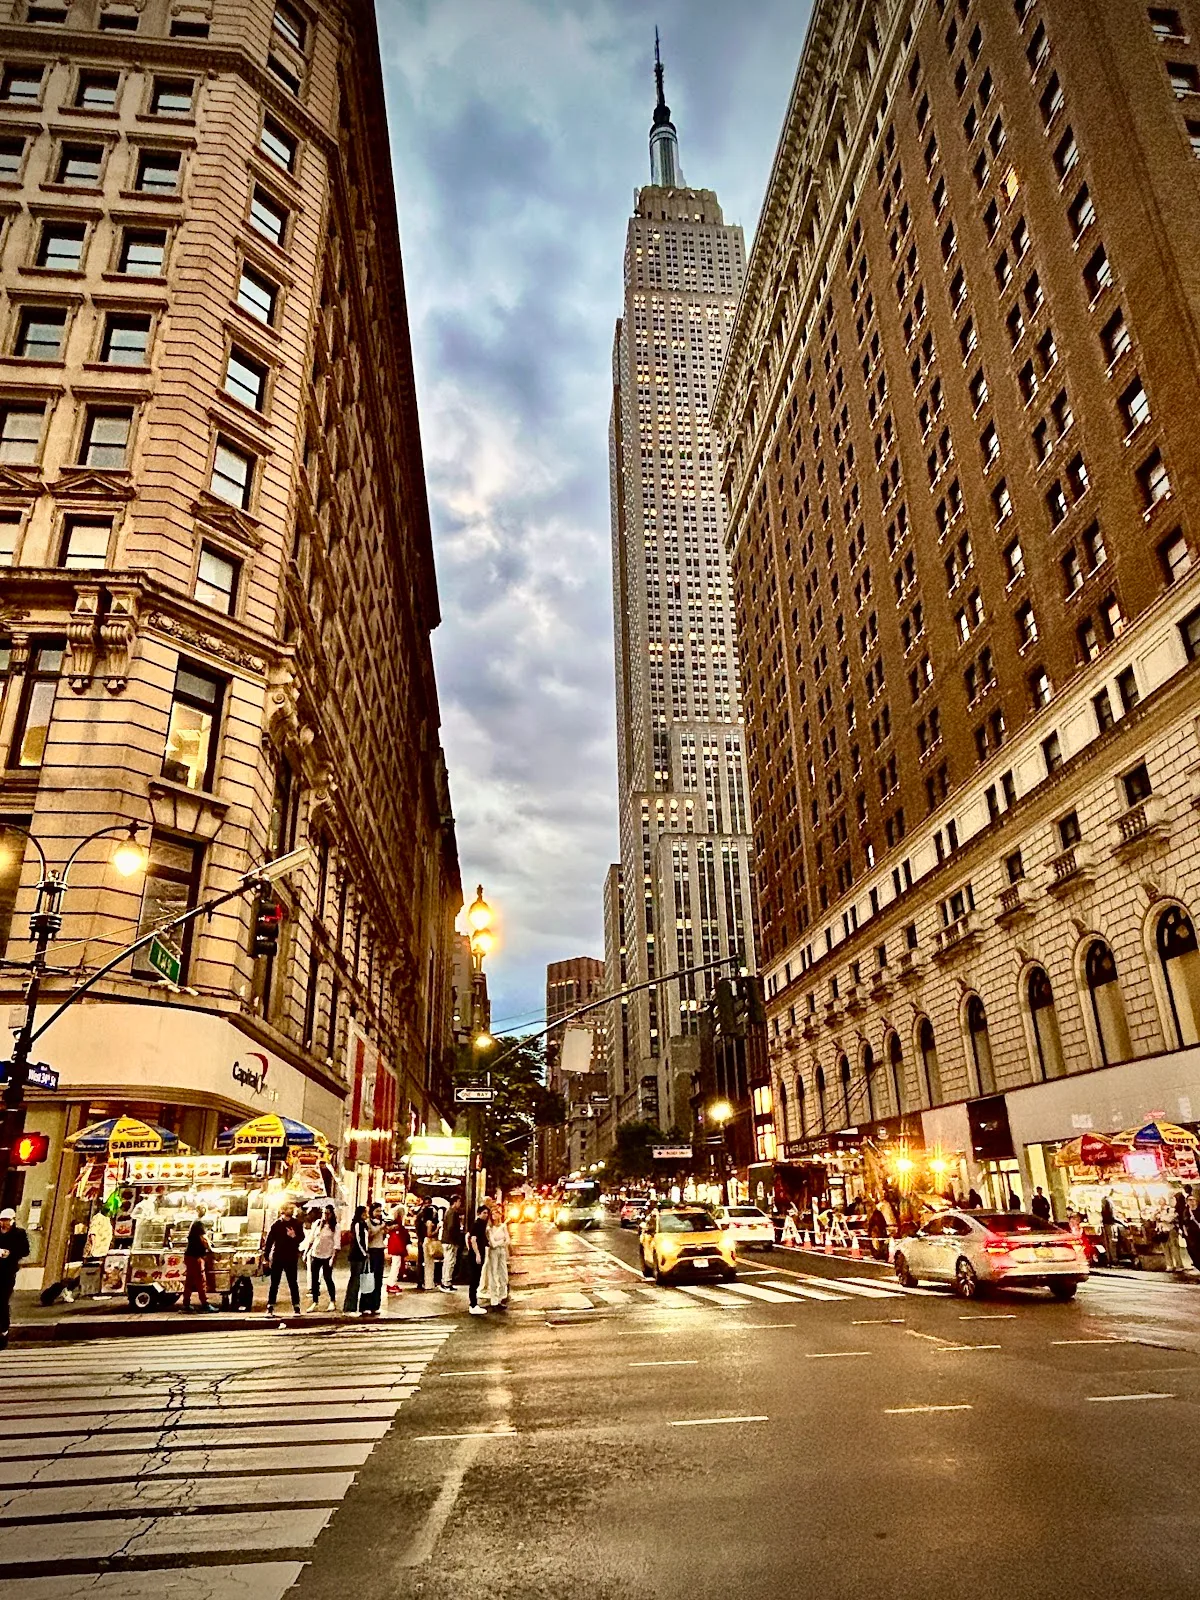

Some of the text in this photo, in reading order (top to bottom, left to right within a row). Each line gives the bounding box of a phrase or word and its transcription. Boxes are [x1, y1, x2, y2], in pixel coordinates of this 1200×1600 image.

[28, 1069, 42, 1083] West
[112, 1141, 159, 1150] SABRETT
[411, 1166, 436, 1176] NEW
